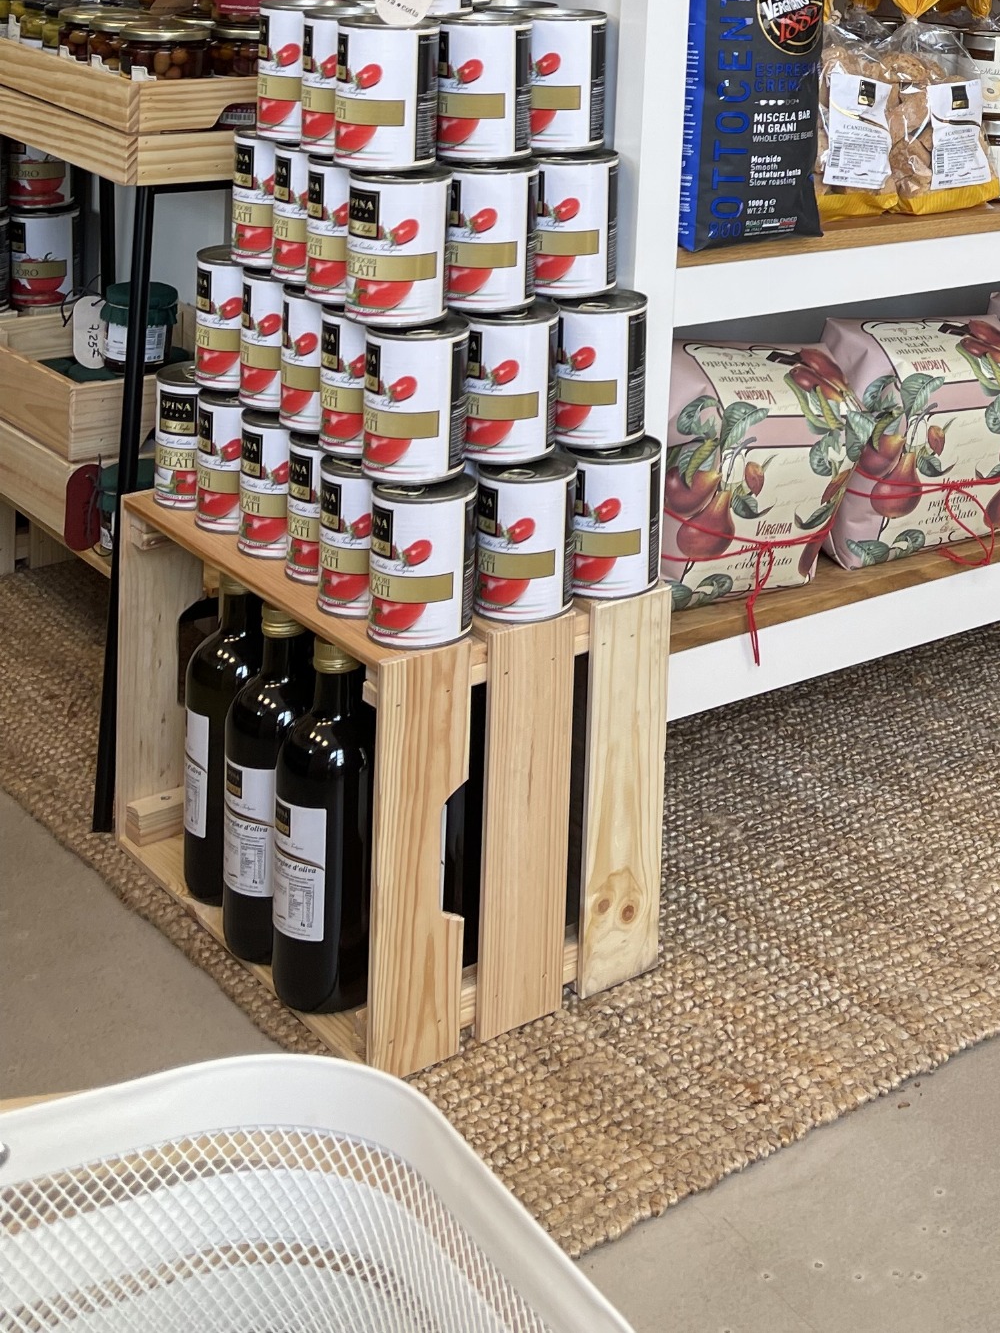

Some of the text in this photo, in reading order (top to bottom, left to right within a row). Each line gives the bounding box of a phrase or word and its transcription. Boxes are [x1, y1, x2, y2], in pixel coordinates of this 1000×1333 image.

[401, 4, 420, 19] cotta
[778, 5, 820, 44] 1882
[754, 110, 811, 123] MISCELA BAR
[752, 123, 797, 133] IN GRANI
[752, 135, 778, 143] WHOLE
[778, 133, 800, 142] COFFEE
[751, 155, 782, 163] Morbido
[750, 163, 778, 171] Smooth
[13, 170, 40, 179] DORO
[750, 169, 802, 179] Tostatura lenta
[749, 177, 796, 187] Slow roasting
[350, 197, 374, 211] PINA
[748, 199, 764, 207] 1000
[350, 261, 376, 277] ELATI
[880, 335, 932, 345] cioccolato
[905, 340, 930, 348] pera
[895, 345, 946, 355] panettone
[702, 360, 760, 369] cioccolato
[911, 359, 951, 373] VIRGINIA
[730, 367, 756, 376] pera
[718, 373, 774, 383] panettone
[734, 389, 776, 405] VIRGINIA
[162, 399, 192, 411] SPINA
[159, 449, 196, 459] POMODORI
[158, 455, 196, 467] PELATI
[756, 521, 792, 537] VIRGINIA
[372, 582, 390, 597] LATI
[244, 820, 268, 833] d'oliva
[292, 861, 317, 875] d'oliva
